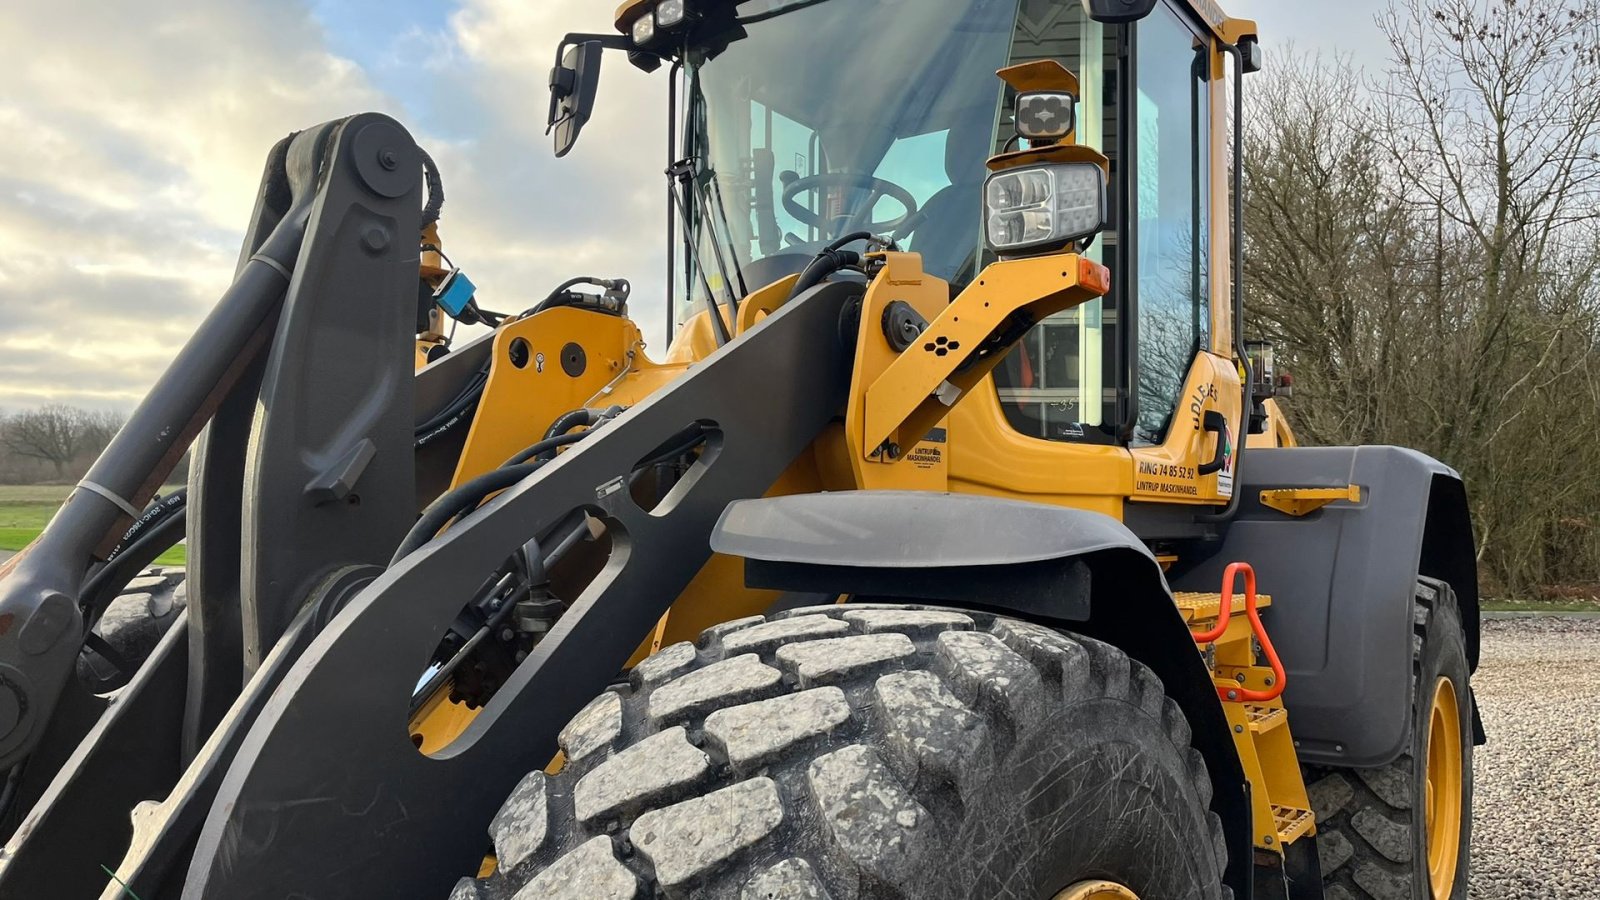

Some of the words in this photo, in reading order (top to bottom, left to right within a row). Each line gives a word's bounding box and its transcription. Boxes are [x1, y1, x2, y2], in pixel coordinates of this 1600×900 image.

[1140, 461, 1158, 475] RING
[1159, 464, 1168, 476] 74
[1169, 465, 1178, 477] 85
[1179, 466, 1187, 478] 52
[1187, 467, 1195, 479] 92
[1137, 481, 1160, 491] LINTRUP
[1160, 483, 1198, 495] MASKINHANDEL
